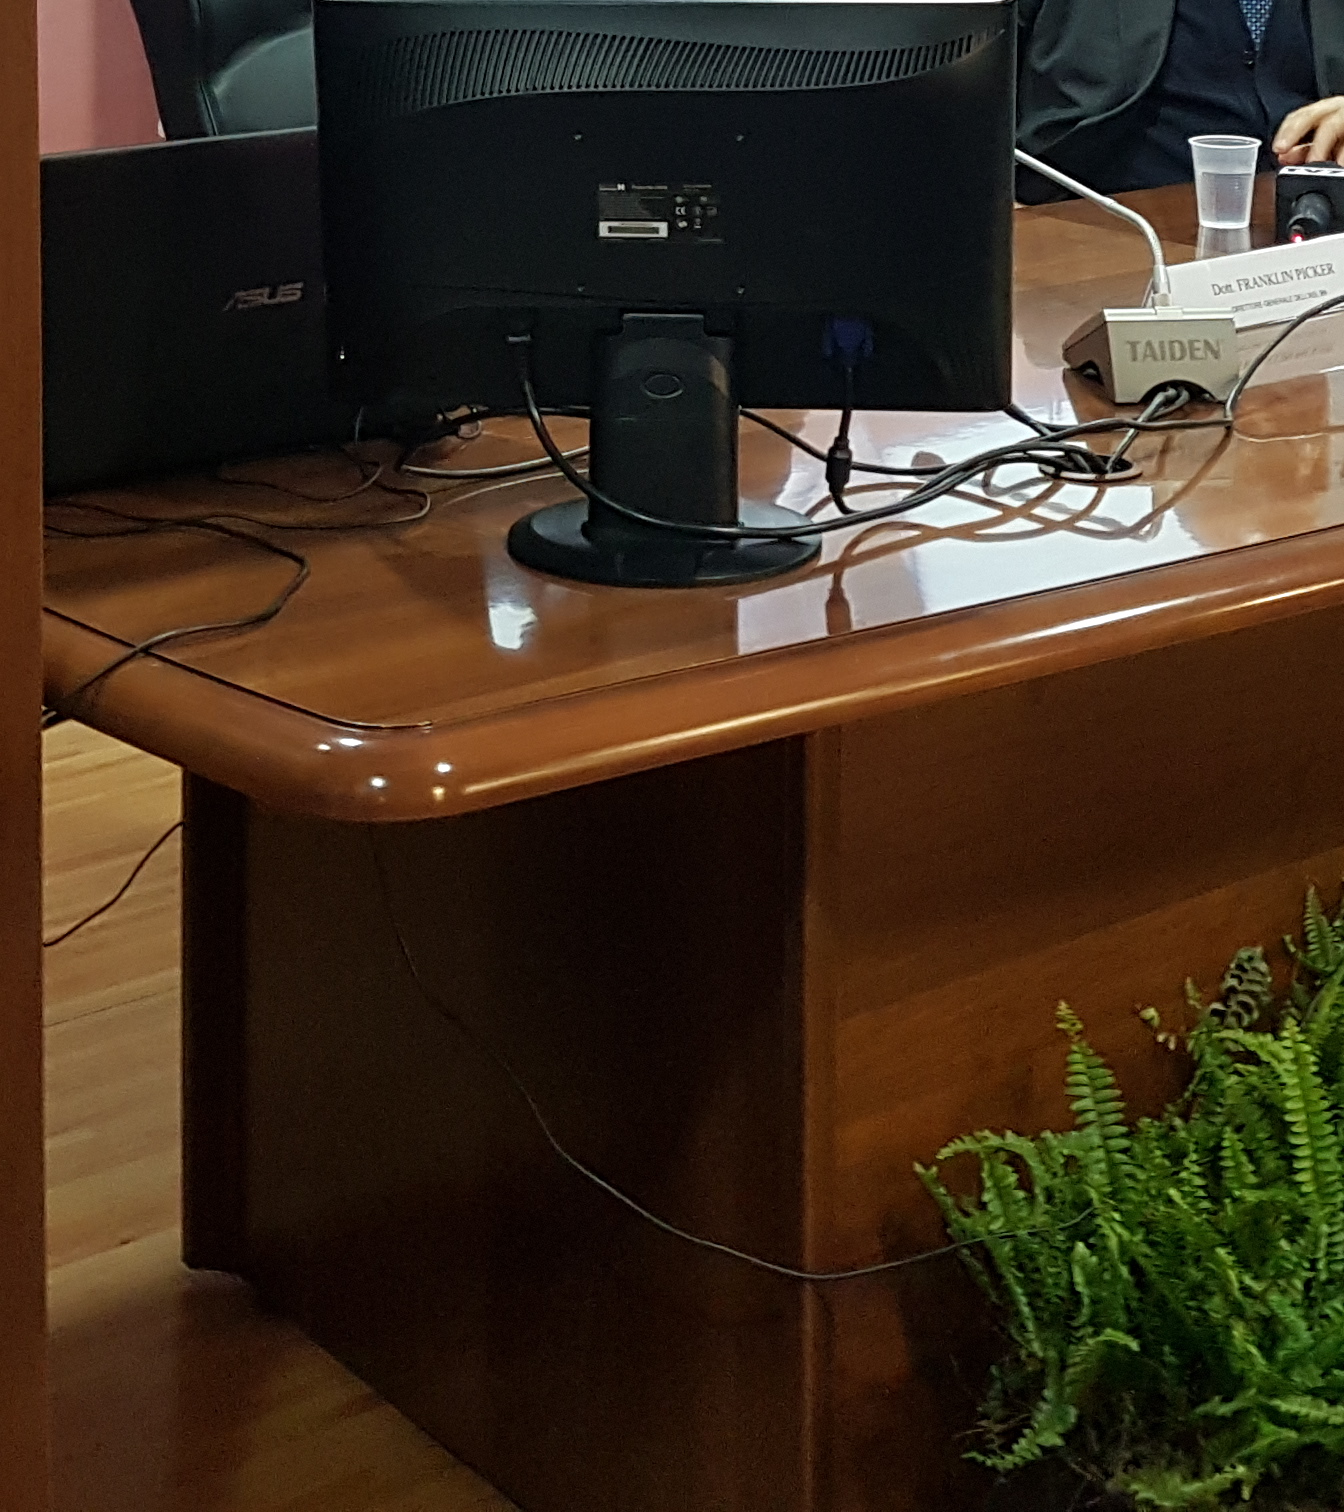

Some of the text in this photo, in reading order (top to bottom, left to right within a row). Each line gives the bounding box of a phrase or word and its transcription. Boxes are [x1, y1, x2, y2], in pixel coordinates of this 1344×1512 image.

[1236, 269, 1295, 292] FRANKLIN
[1295, 262, 1336, 281] PICKER
[221, 281, 305, 312] ASUS
[1125, 338, 1223, 363] TAIDEN
